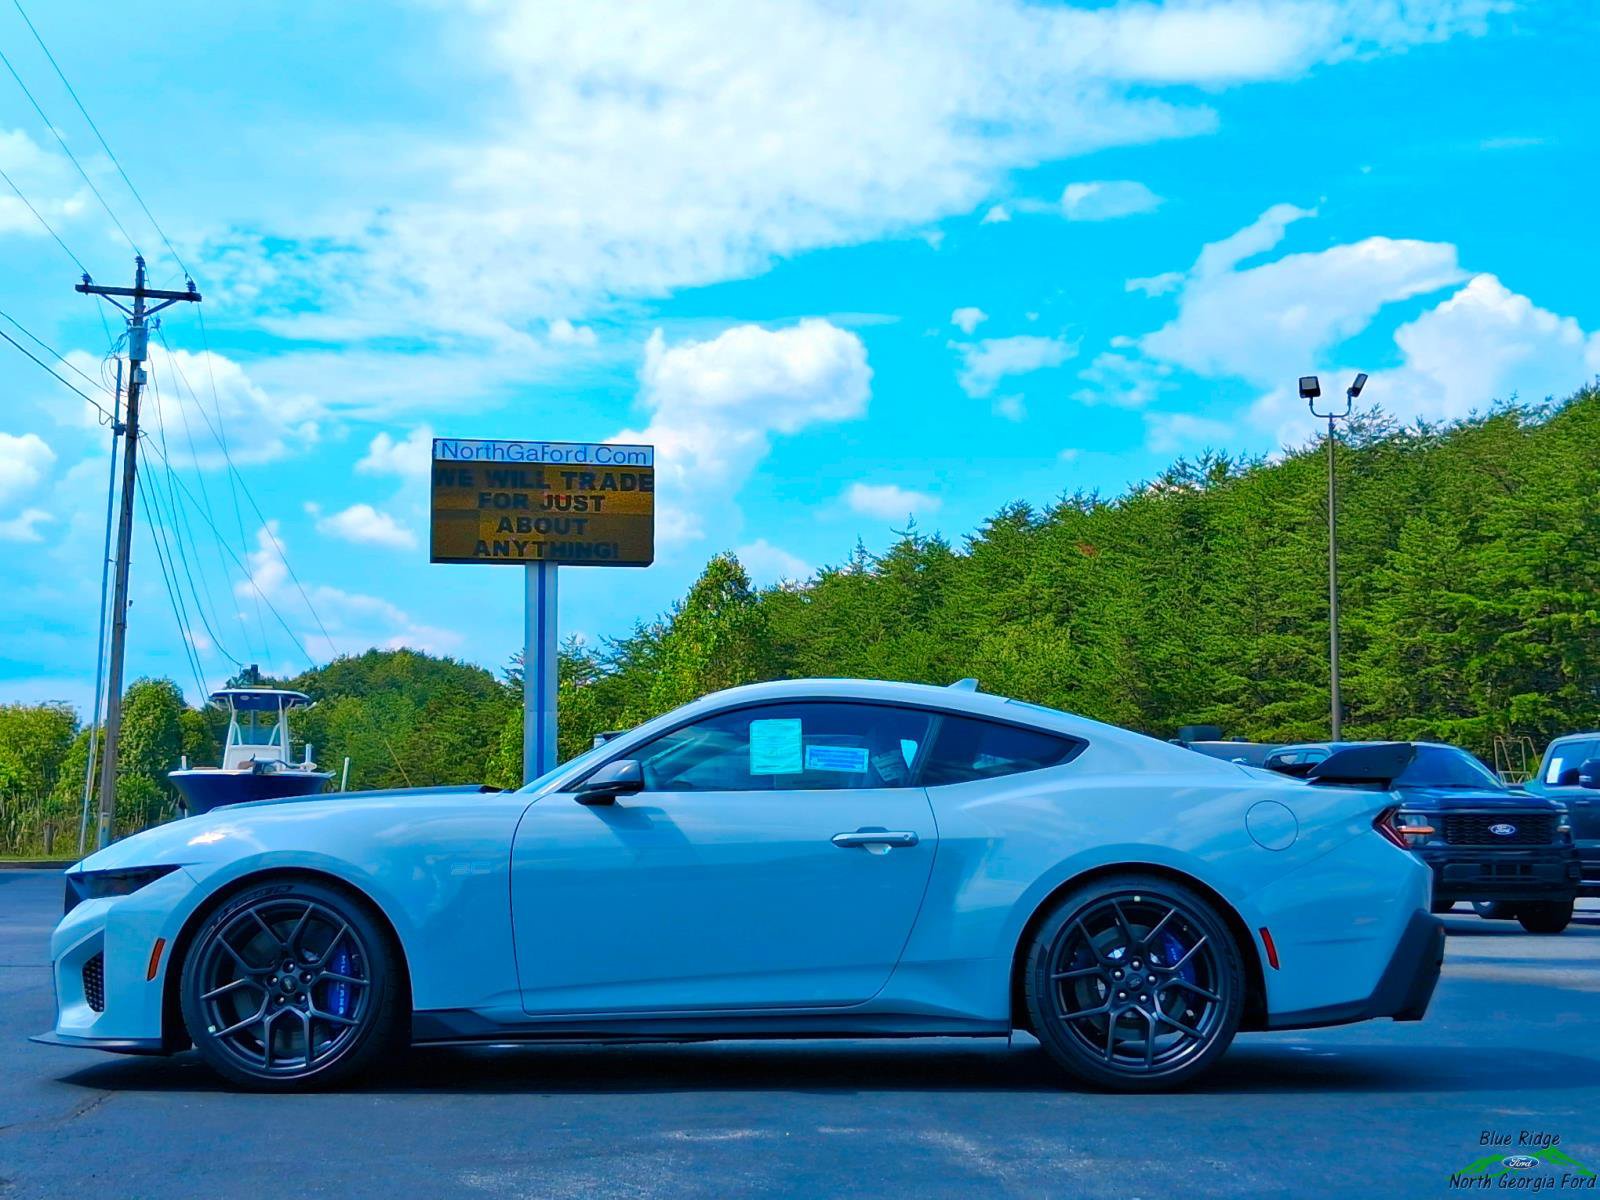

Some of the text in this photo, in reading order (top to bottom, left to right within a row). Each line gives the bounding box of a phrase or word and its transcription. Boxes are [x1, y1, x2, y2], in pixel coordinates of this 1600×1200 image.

[441, 441, 648, 465] NorthGaFord.Com
[437, 468, 653, 492] WE WILL TRADE
[478, 492, 606, 512] FOR JUST
[496, 517, 589, 535] ABOUT
[472, 540, 620, 559] ANYTHING!
